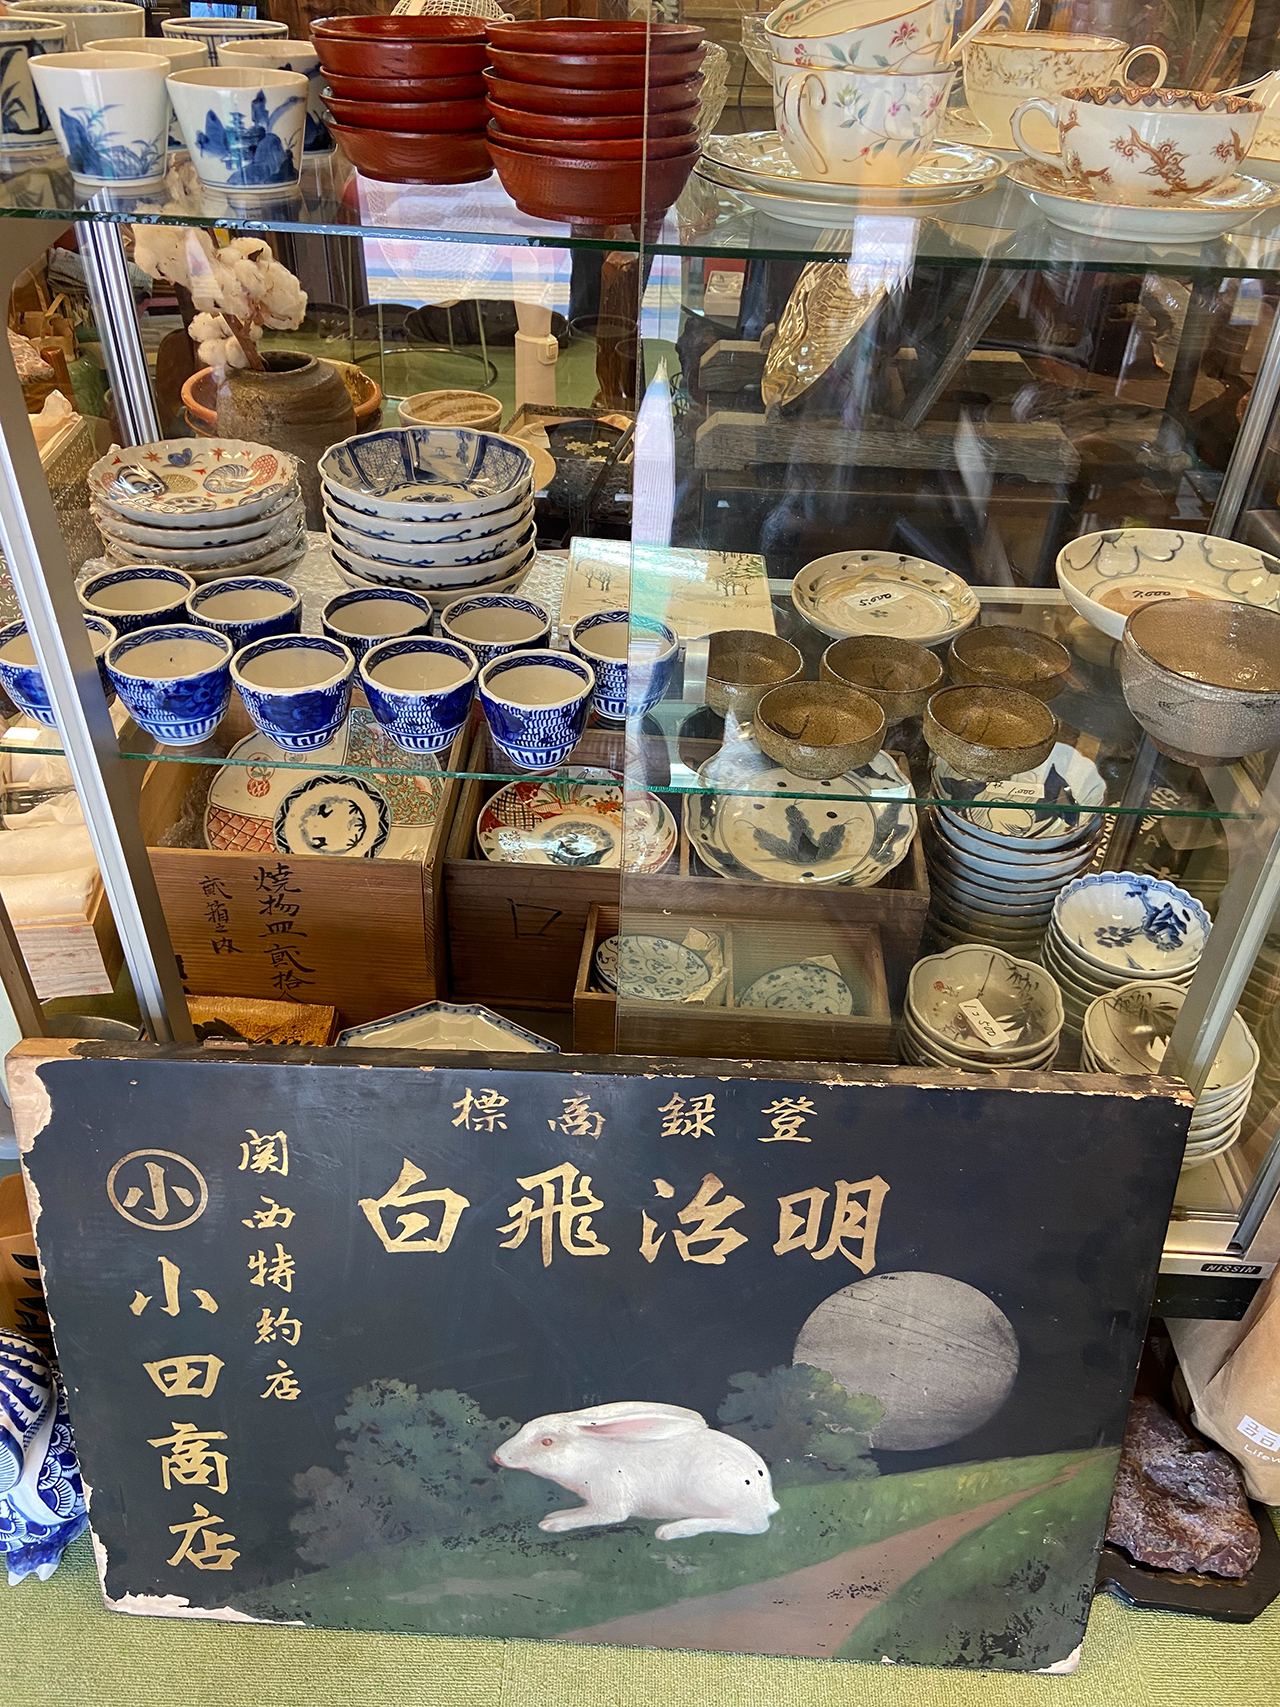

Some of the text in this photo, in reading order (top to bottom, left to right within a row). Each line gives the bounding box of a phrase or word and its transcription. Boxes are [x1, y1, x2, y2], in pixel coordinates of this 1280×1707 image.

[1205, 1264, 1256, 1273] NISSIN
[129, 1256, 241, 1570] 小田商店
